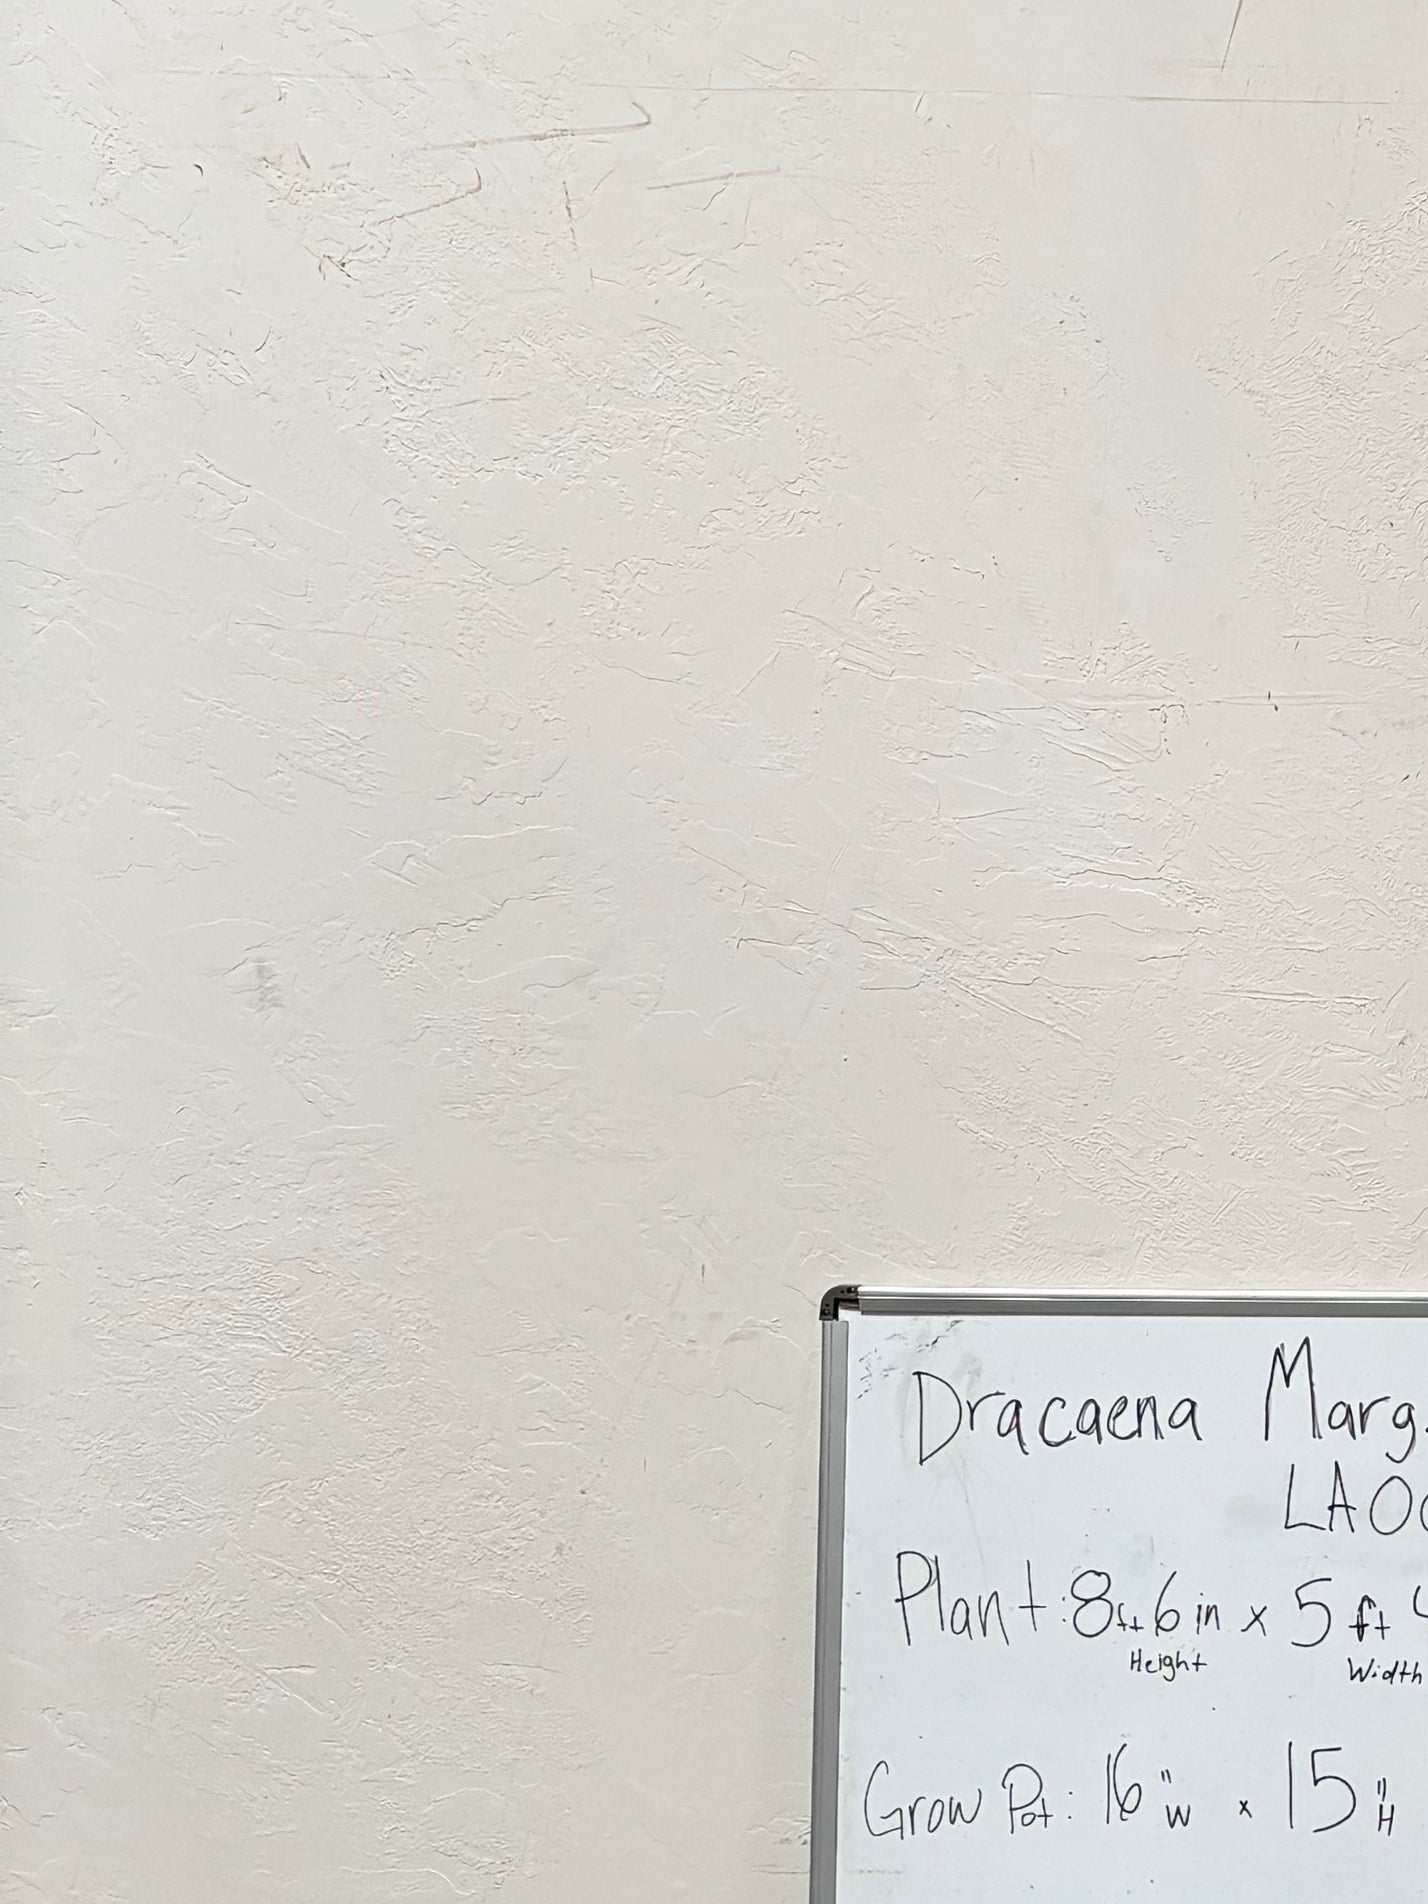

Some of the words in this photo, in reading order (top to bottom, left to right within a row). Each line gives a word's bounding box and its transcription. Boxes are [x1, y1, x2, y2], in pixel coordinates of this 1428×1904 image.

[910, 1369, 1204, 1468] Dracaena
[1239, 1604, 1269, 1638] x
[1129, 1646, 1209, 1684] Height
[1345, 1655, 1424, 1687] Width
[862, 1758, 984, 1842] Grow
[1000, 1762, 1075, 1836] Pot:
[1237, 1798, 1254, 1820] x
